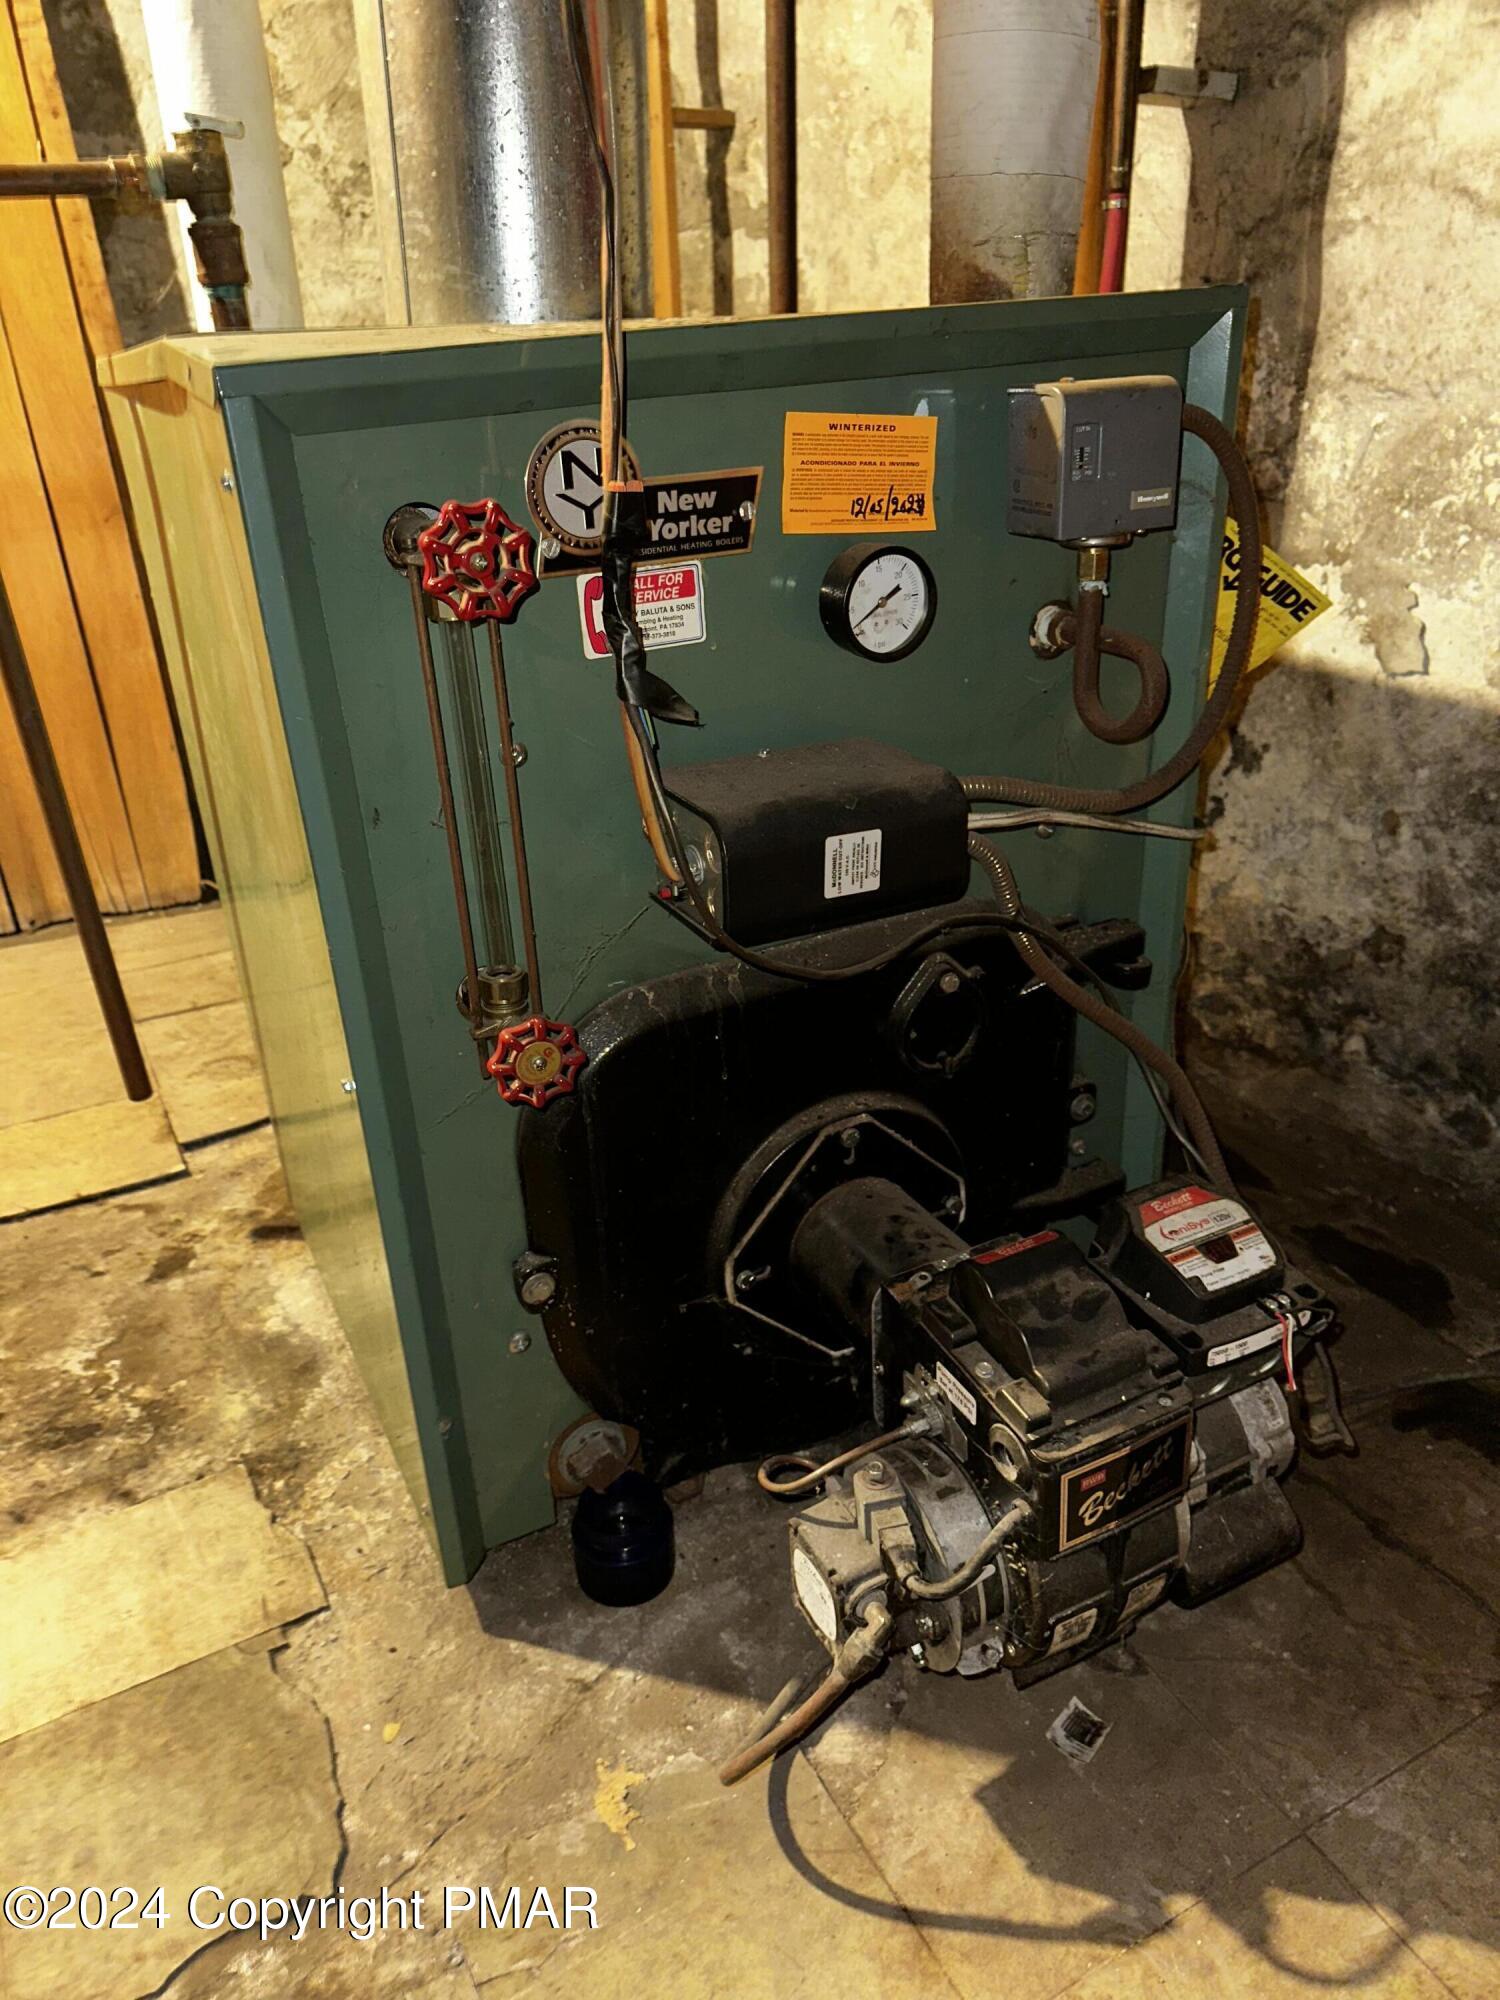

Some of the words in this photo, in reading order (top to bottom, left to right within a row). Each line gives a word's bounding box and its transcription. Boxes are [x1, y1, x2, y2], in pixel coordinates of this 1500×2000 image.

[828, 423, 896, 432] WINTERIZED
[800, 459, 857, 467] ACONDICIONADO
[657, 489, 717, 514] New
[648, 514, 733, 541] Yorker
[640, 544, 678, 556] SIDENTIAL
[680, 538, 713, 551] HEATING
[715, 535, 744, 547] BOILERS
[634, 575, 655, 589] ALL
[658, 572, 684, 587] FOR
[635, 586, 680, 603] ERVICE
[640, 606, 668, 616] BALUTA
[676, 602, 695, 612] SONS
[1078, 1436, 1174, 1527] Beckett
